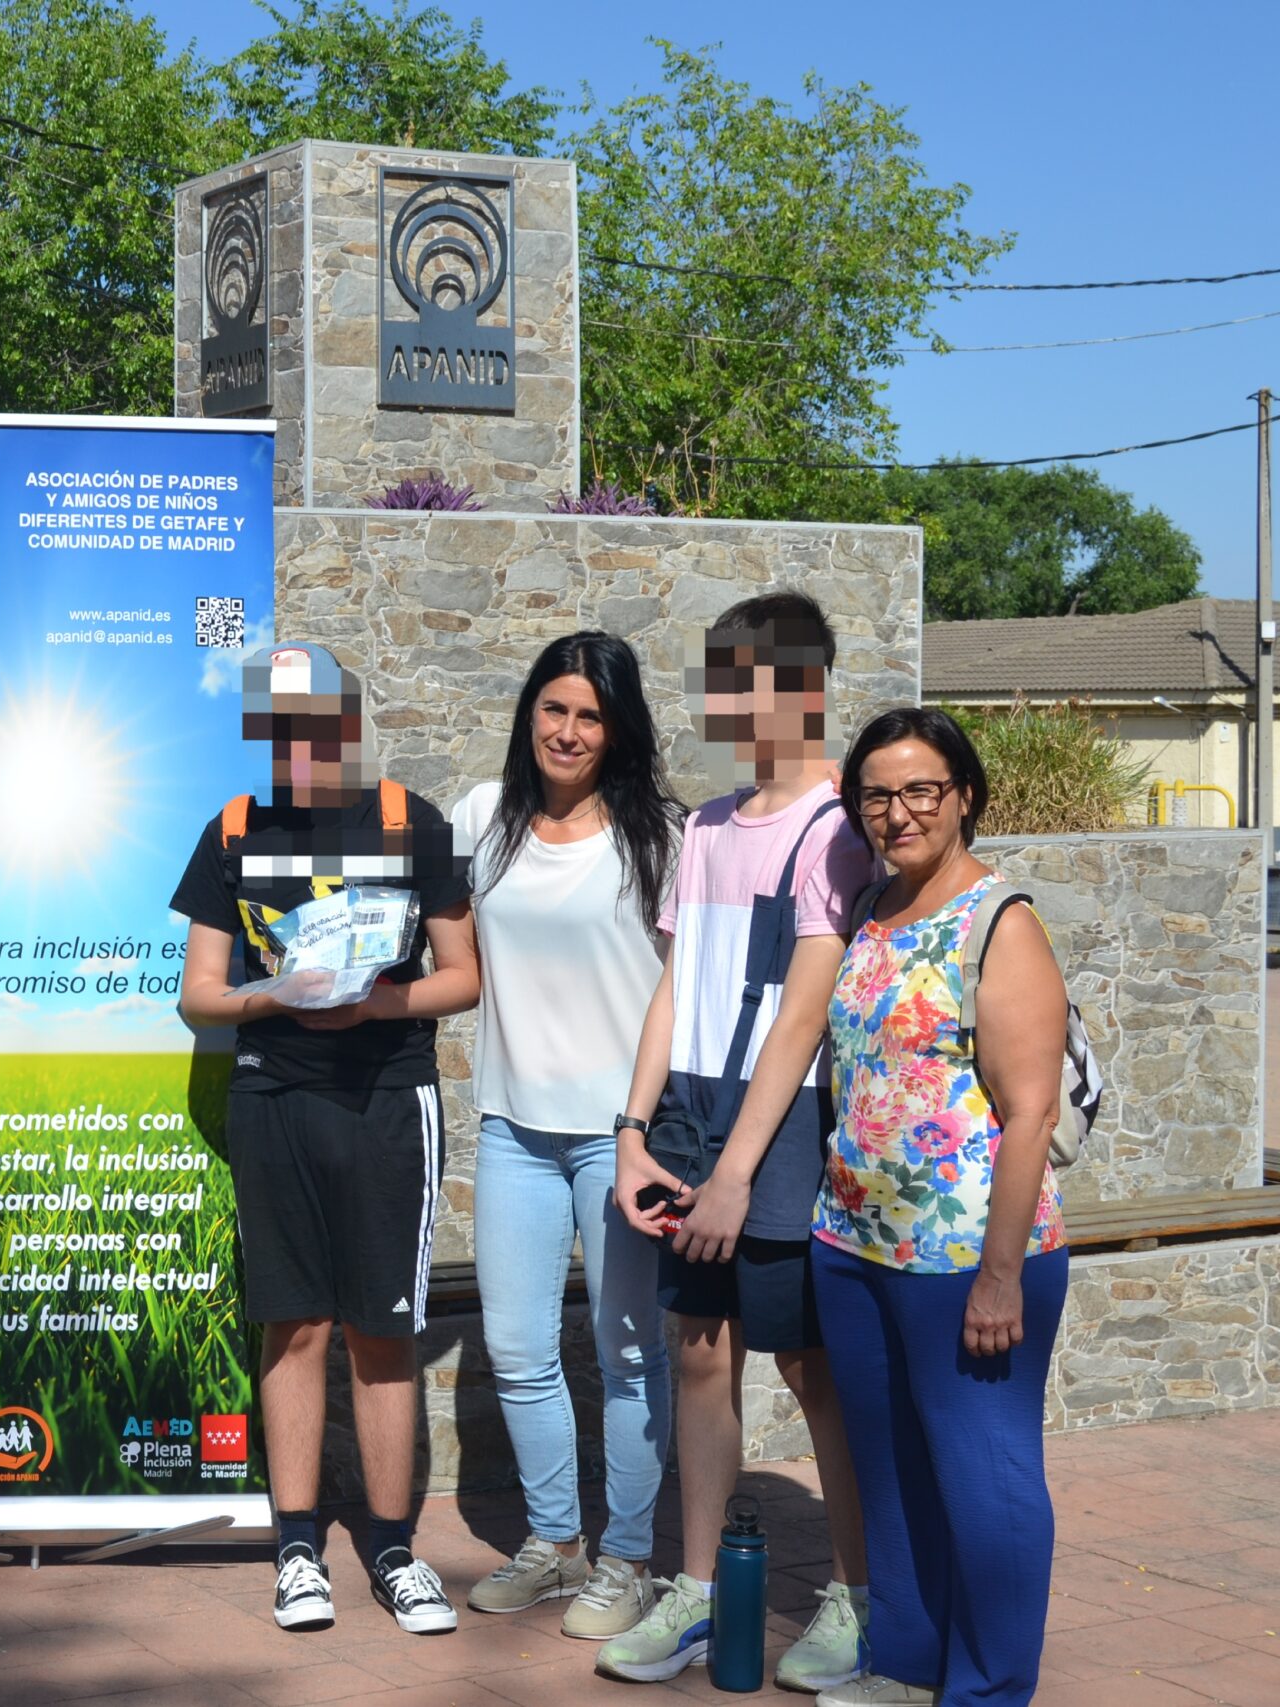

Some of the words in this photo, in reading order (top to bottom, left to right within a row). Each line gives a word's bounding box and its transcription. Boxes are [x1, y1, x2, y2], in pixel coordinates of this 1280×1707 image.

[387, 345, 509, 385] APANID
[25, 470, 135, 488] ASOCIACIÓN
[139, 474, 163, 489] DE
[168, 475, 239, 491] PADRES
[46, 493, 59, 508] Y
[62, 493, 131, 509] AMIGOS
[136, 494, 160, 509] DE
[164, 492, 218, 511] NIÑOS
[19, 513, 127, 529] DIFERENTES
[132, 515, 156, 529] DE
[160, 515, 229, 532] GETAFE
[233, 517, 245, 532] Y
[28, 533, 135, 549] COMUNIDAD
[140, 535, 163, 550] DE
[168, 536, 236, 552] MADRID
[69, 609, 171, 624] www.apanid.es
[46, 630, 173, 646] apanid@apanid.es
[33, 935, 152, 959] inclusión
[96, 970, 129, 994] de
[138, 971, 182, 994] tod
[139, 1112, 184, 1131] con
[65, 1144, 89, 1171] la
[98, 1144, 209, 1170] inclusión
[102, 1183, 202, 1217] integral
[9, 1231, 125, 1258] personas
[135, 1231, 181, 1251] con
[79, 1262, 218, 1291] intelectual
[39, 1304, 139, 1332] familias
[144, 1441, 192, 1457] Plena
[144, 1456, 192, 1467] inclusión
[143, 1469, 173, 1478] Madrid
[201, 1471, 213, 1479] de
[215, 1470, 248, 1479] Madrid
